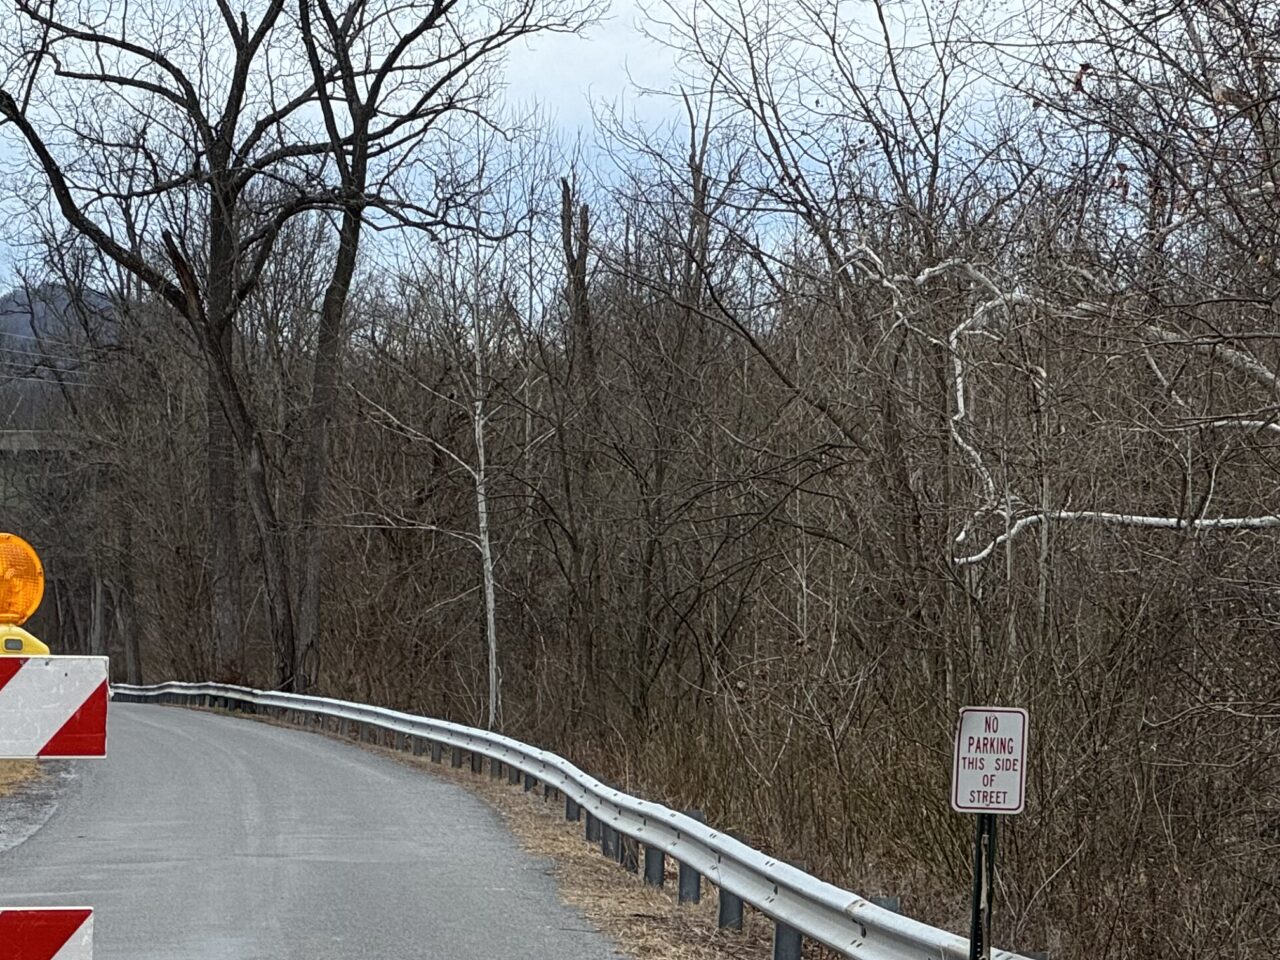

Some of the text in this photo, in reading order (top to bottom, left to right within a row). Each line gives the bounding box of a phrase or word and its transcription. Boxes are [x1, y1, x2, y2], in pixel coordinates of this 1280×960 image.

[984, 716, 999, 733] NO
[968, 736, 1014, 754] PARKING
[962, 757, 1019, 771] THIS SIDE
[982, 774, 996, 787] OF
[969, 790, 1008, 804] STREET
